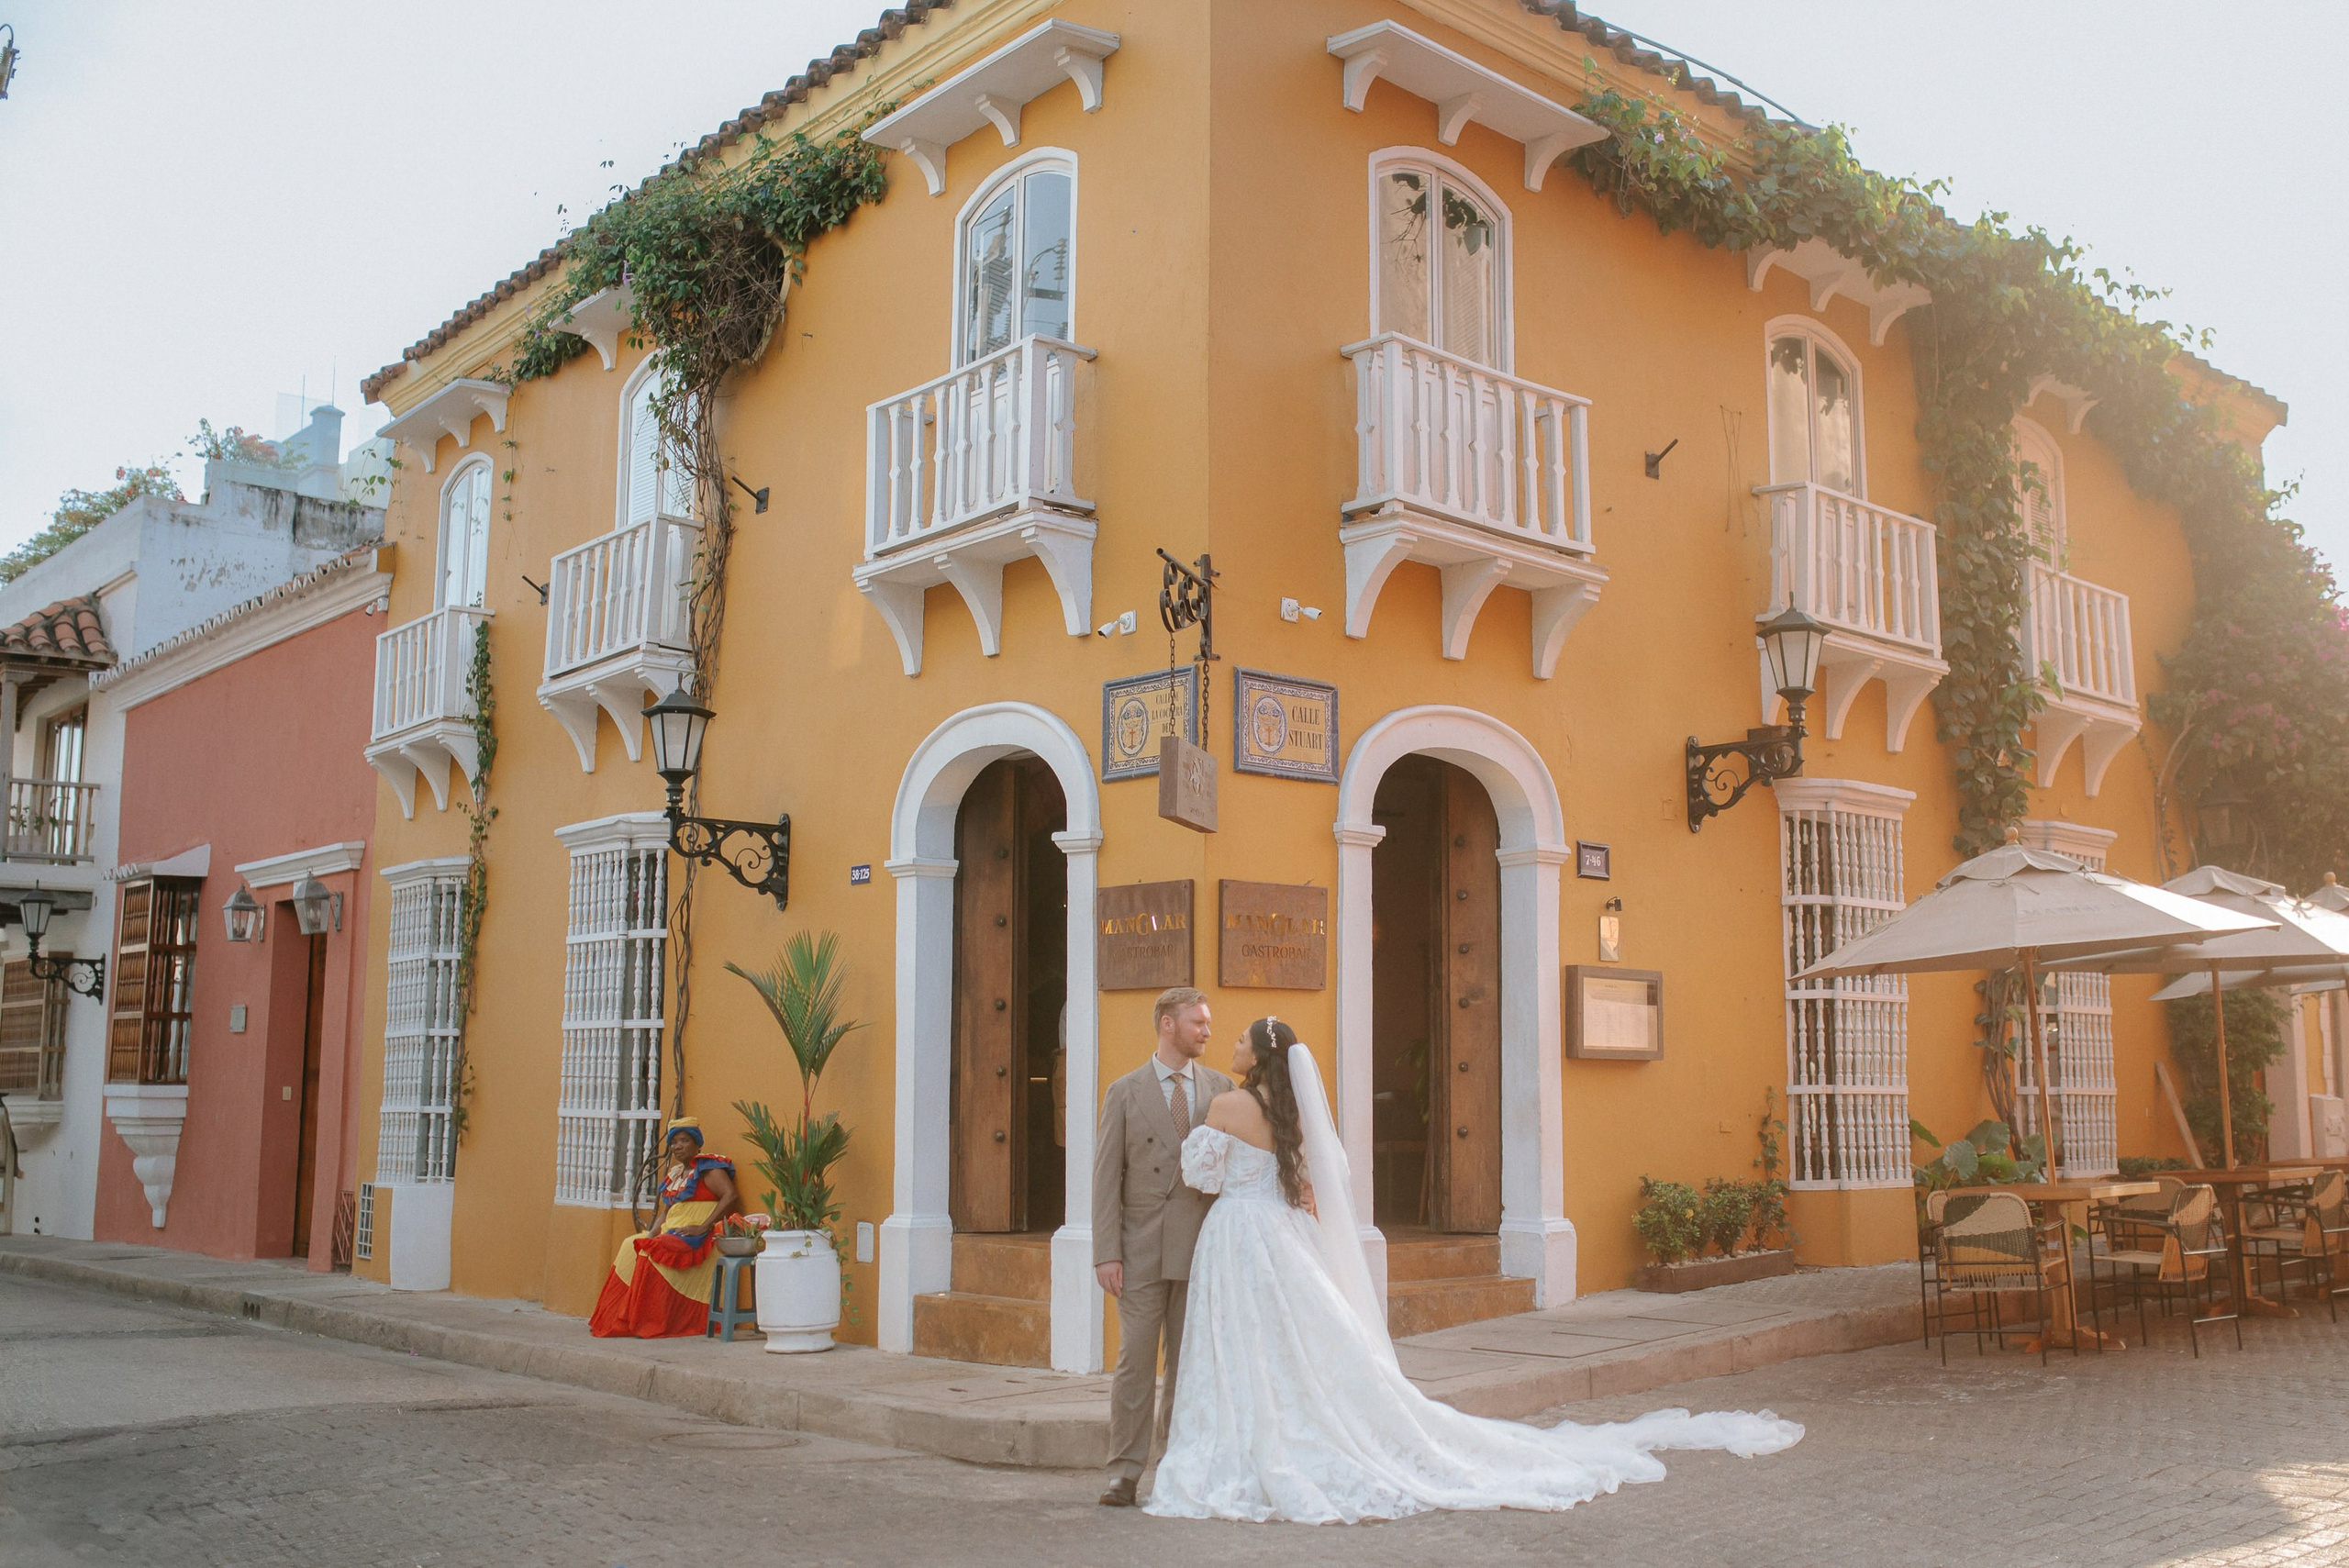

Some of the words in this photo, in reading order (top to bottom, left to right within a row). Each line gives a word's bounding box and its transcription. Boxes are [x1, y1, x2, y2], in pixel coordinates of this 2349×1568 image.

[1152, 709, 1159, 721] LA
[1292, 706, 1320, 725] CALLE
[1288, 729, 1323, 751] STUART
[1100, 912, 1186, 936] MANGLAR
[1226, 912, 1325, 937] MANGLAR
[1241, 944, 1311, 960] GASTROBAR
